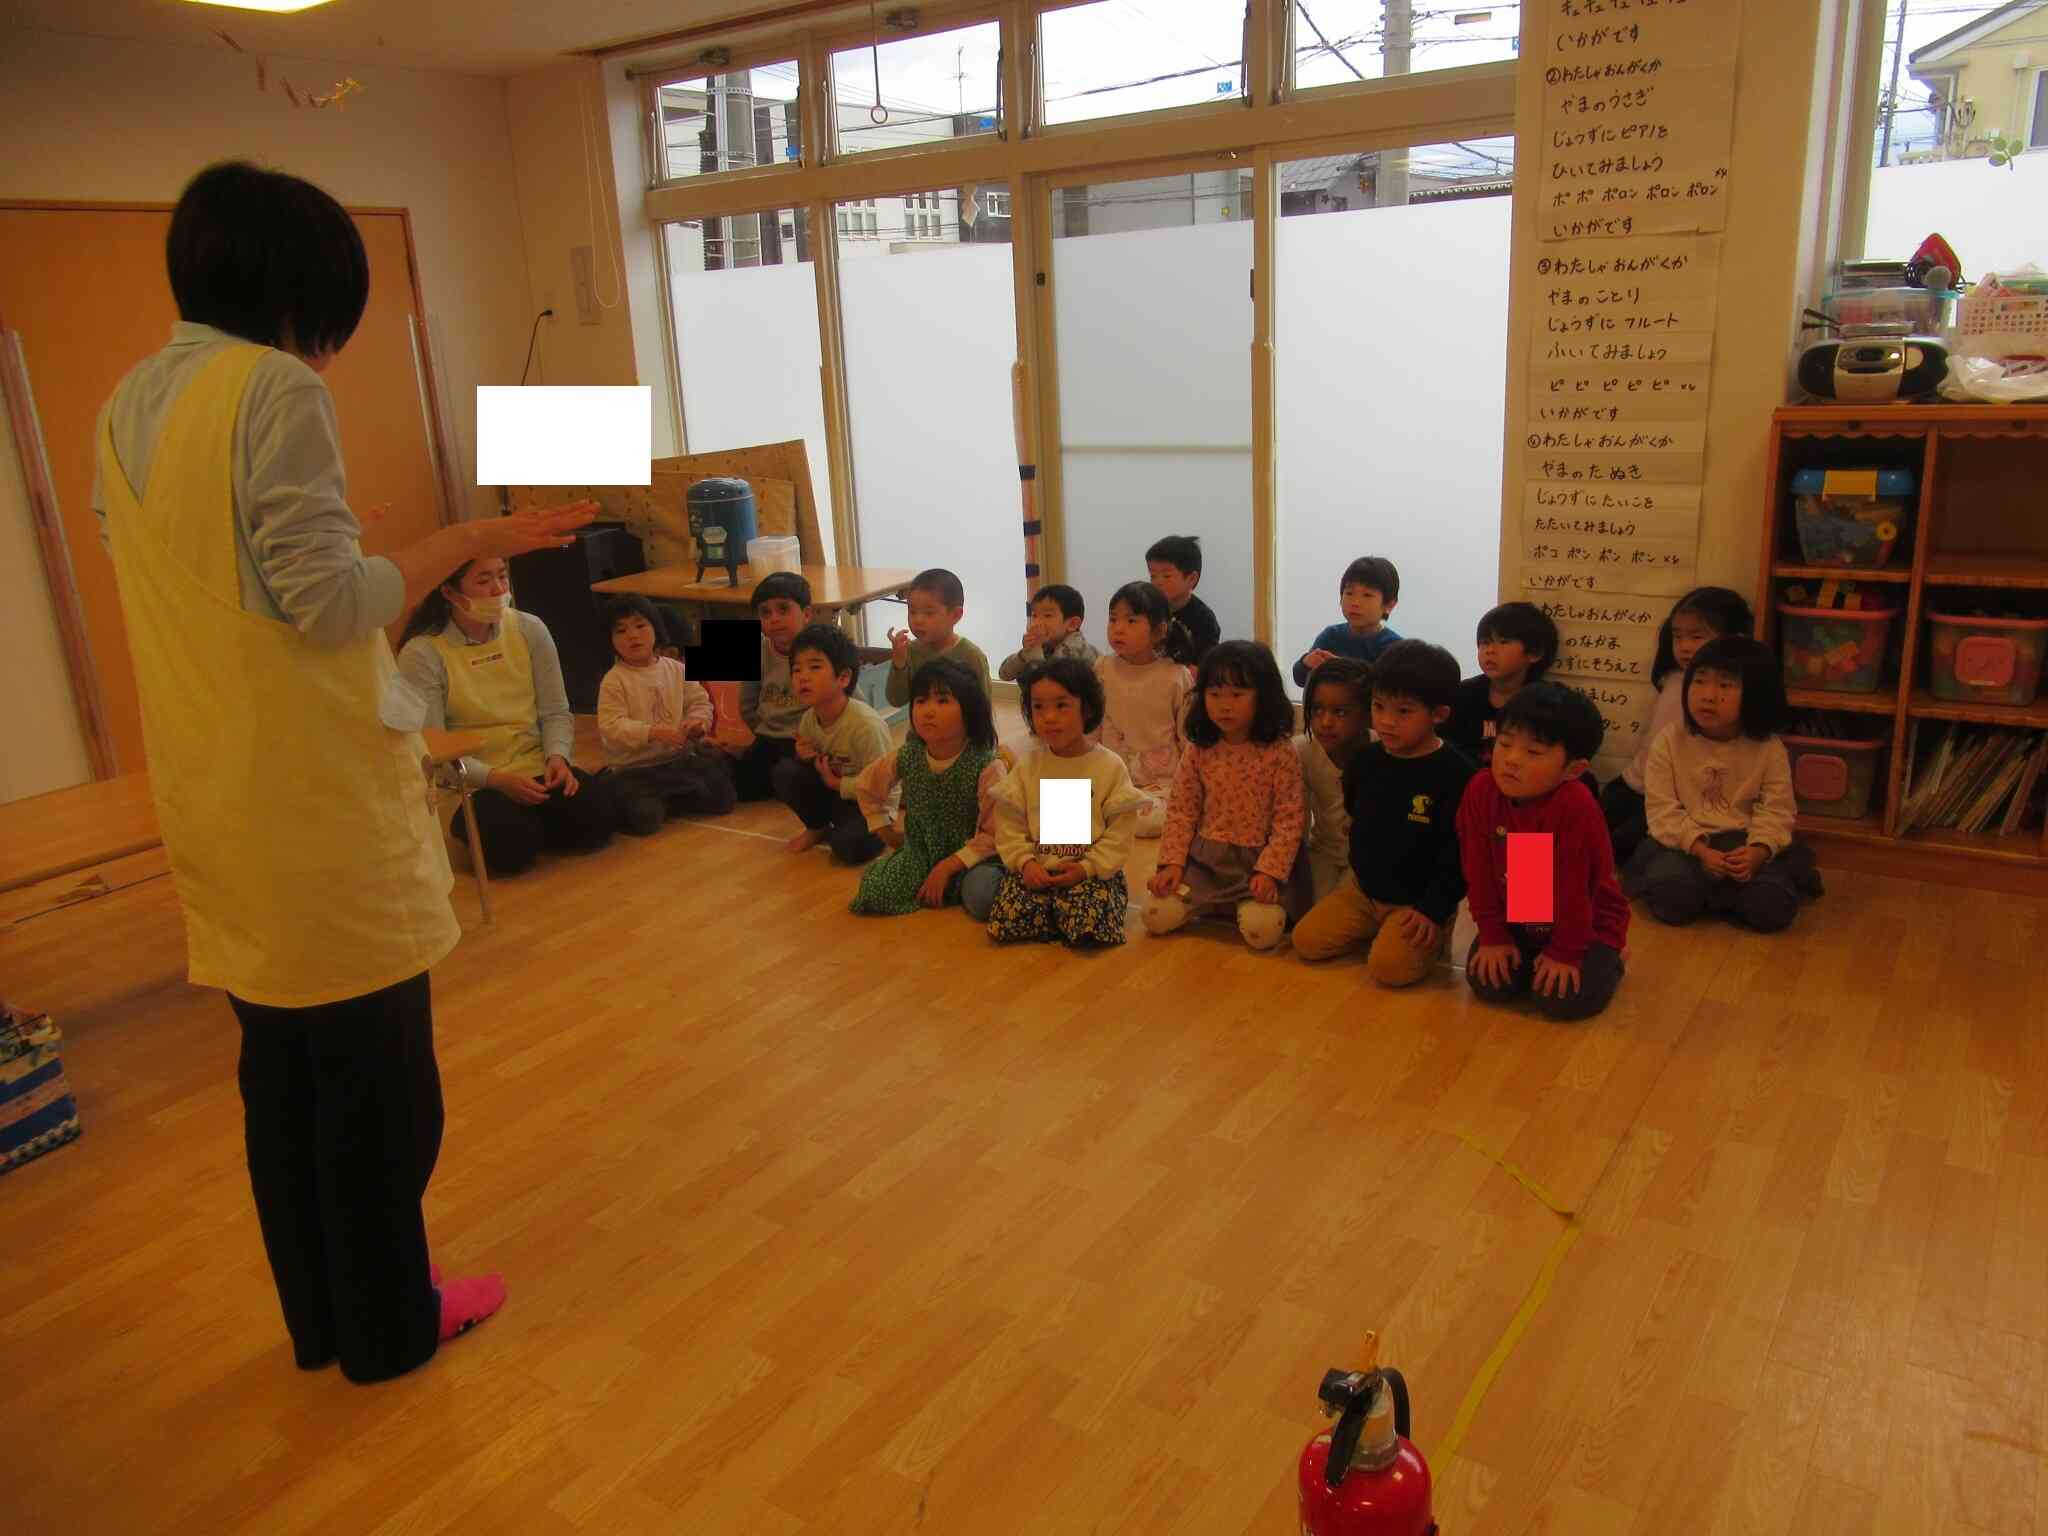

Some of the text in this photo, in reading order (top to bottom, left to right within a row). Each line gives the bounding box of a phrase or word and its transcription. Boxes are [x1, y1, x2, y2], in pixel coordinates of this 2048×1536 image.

[1557, 24, 1638, 51] いかがです
[1561, 87, 1654, 114] やまのうさぎ
[1553, 153, 1663, 179] ひいてみましょう
[1554, 216, 1632, 239] いかがです
[1548, 288, 1639, 305] やまのことり
[1548, 342, 1667, 360] ふいてみましょう
[1541, 406, 1618, 422] いかがです
[1542, 460, 1642, 480] やまのたぬき
[1535, 517, 1635, 536] たたいてみましょう
[1529, 575, 1597, 588] いかがです
